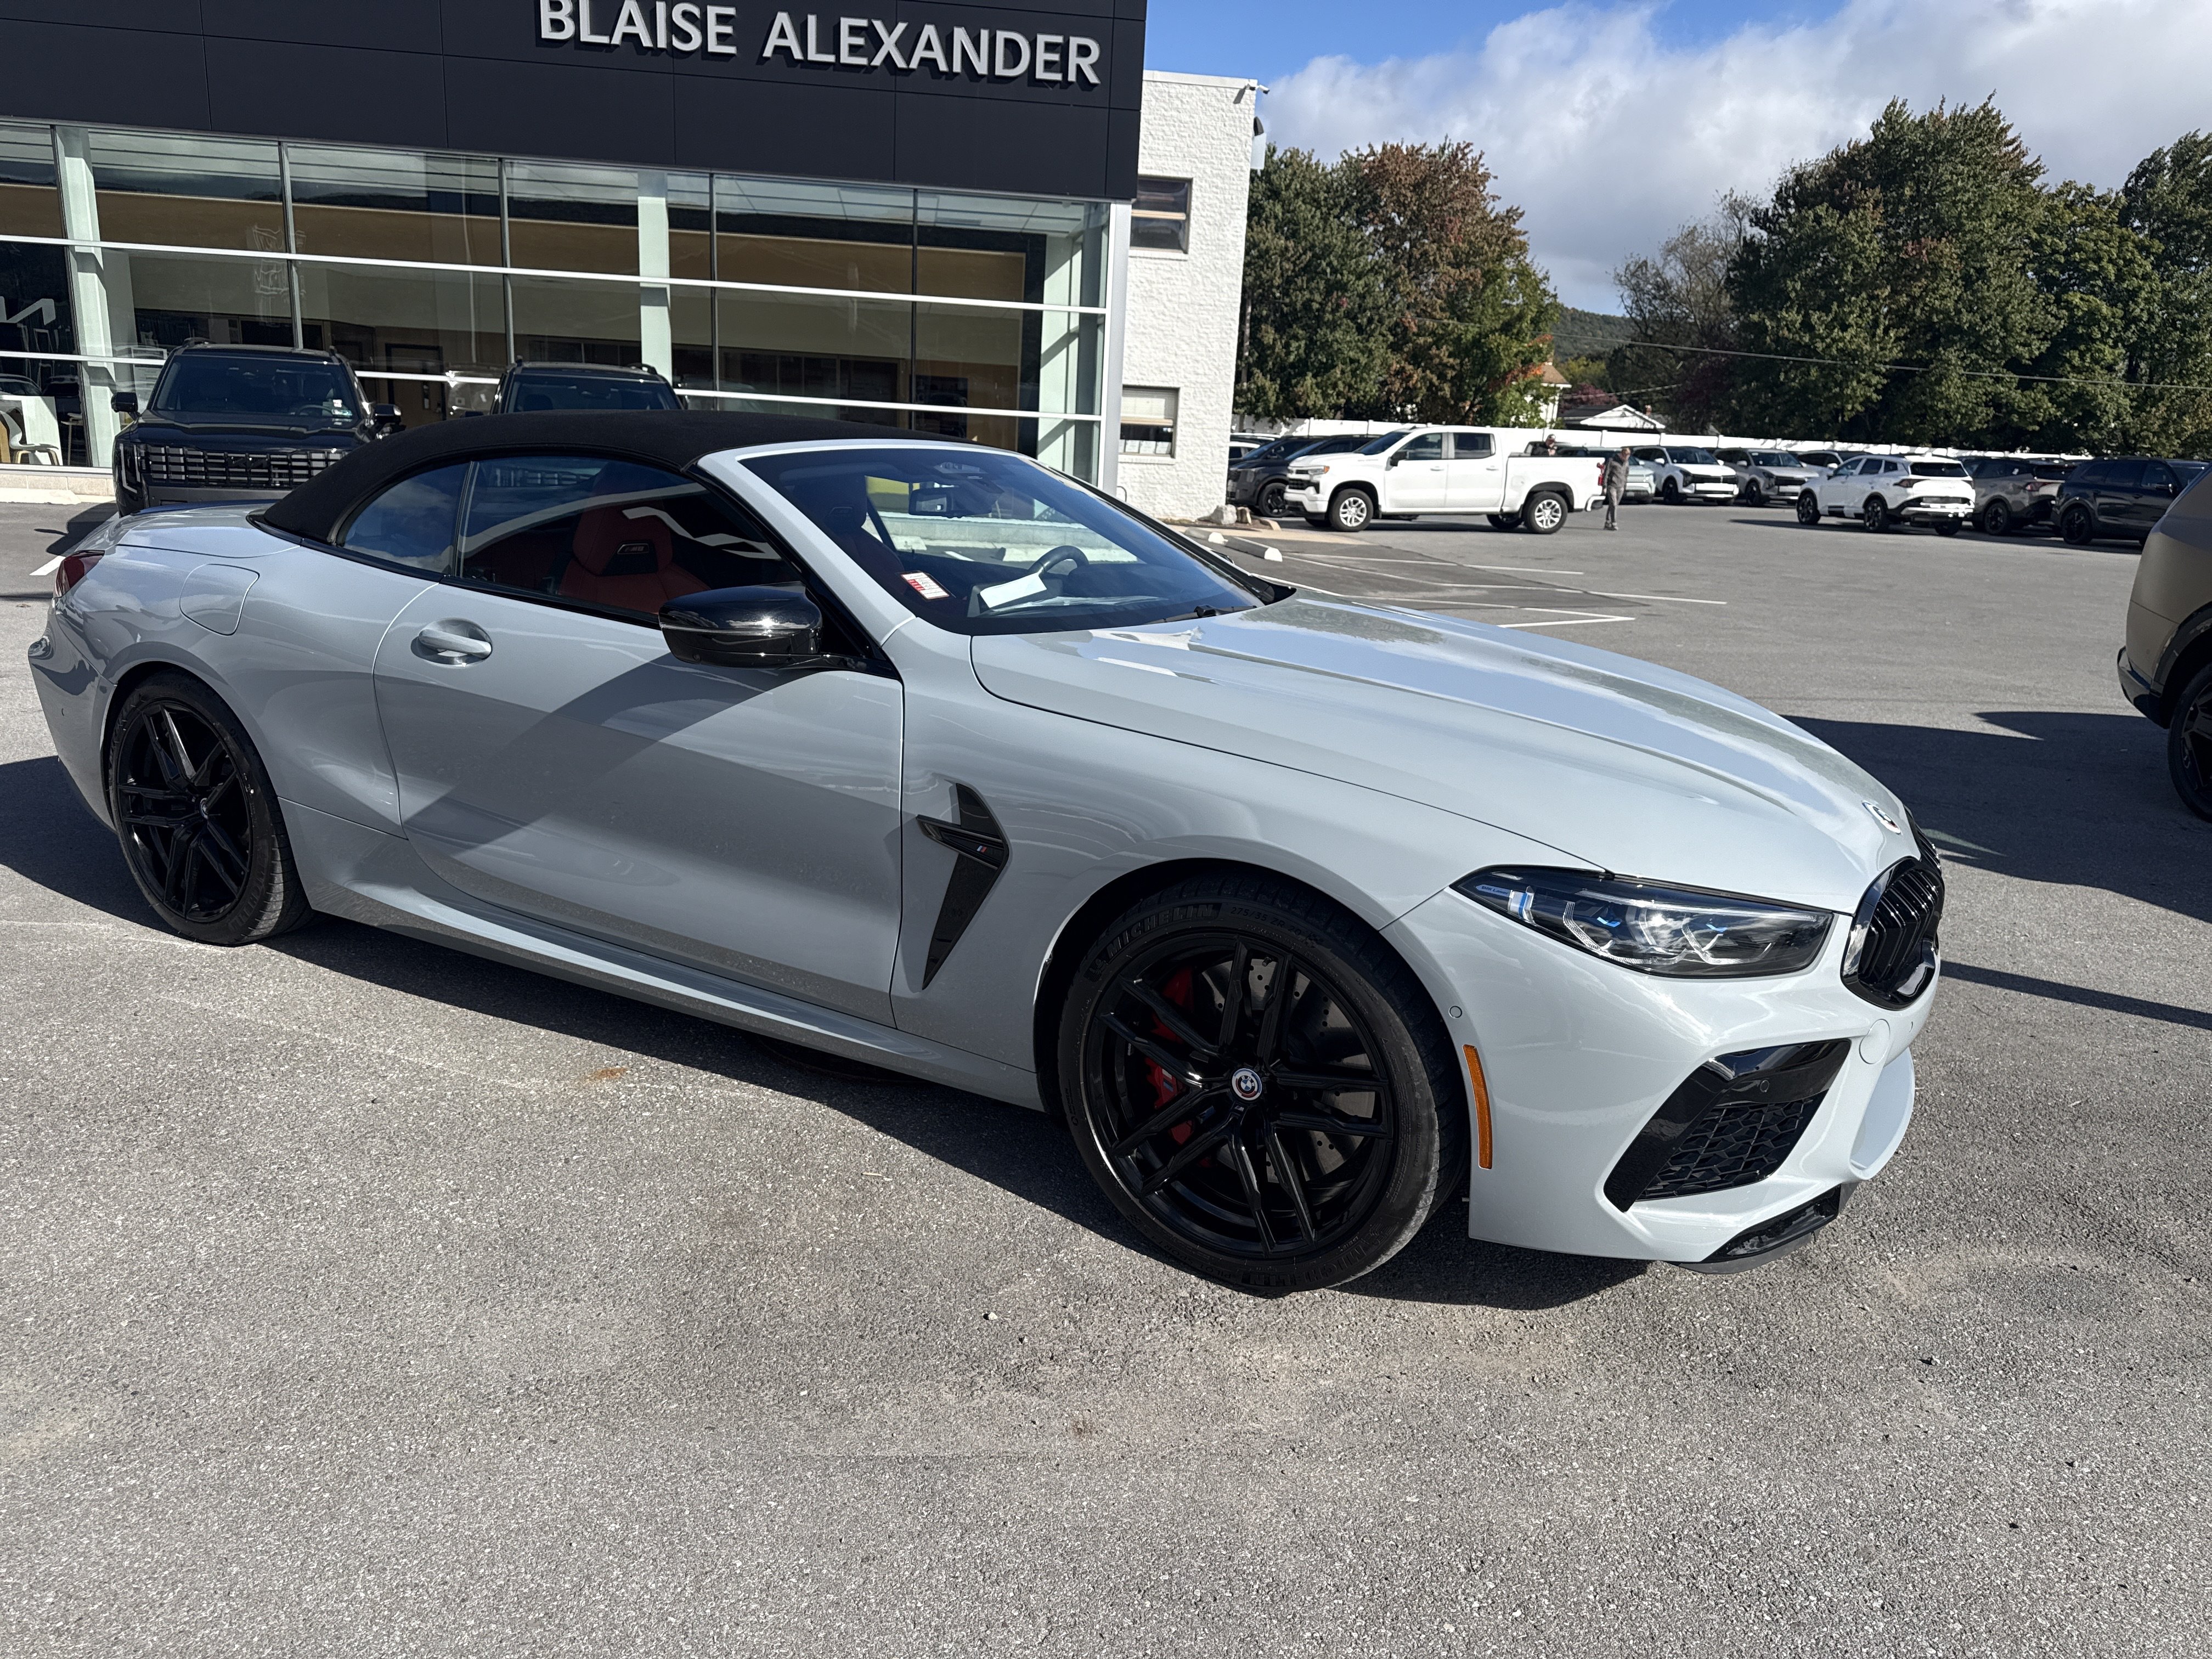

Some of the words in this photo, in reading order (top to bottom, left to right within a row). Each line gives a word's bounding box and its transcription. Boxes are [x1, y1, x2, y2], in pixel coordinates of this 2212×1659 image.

[540, 0, 737, 54] BLAISE
[763, 12, 1101, 83] ALEXANDER
[1107, 904, 1214, 958] MICHELIN
[1231, 906, 1268, 921] 275/35
[1271, 918, 1286, 928] ZR
[1287, 924, 1302, 935] 20
